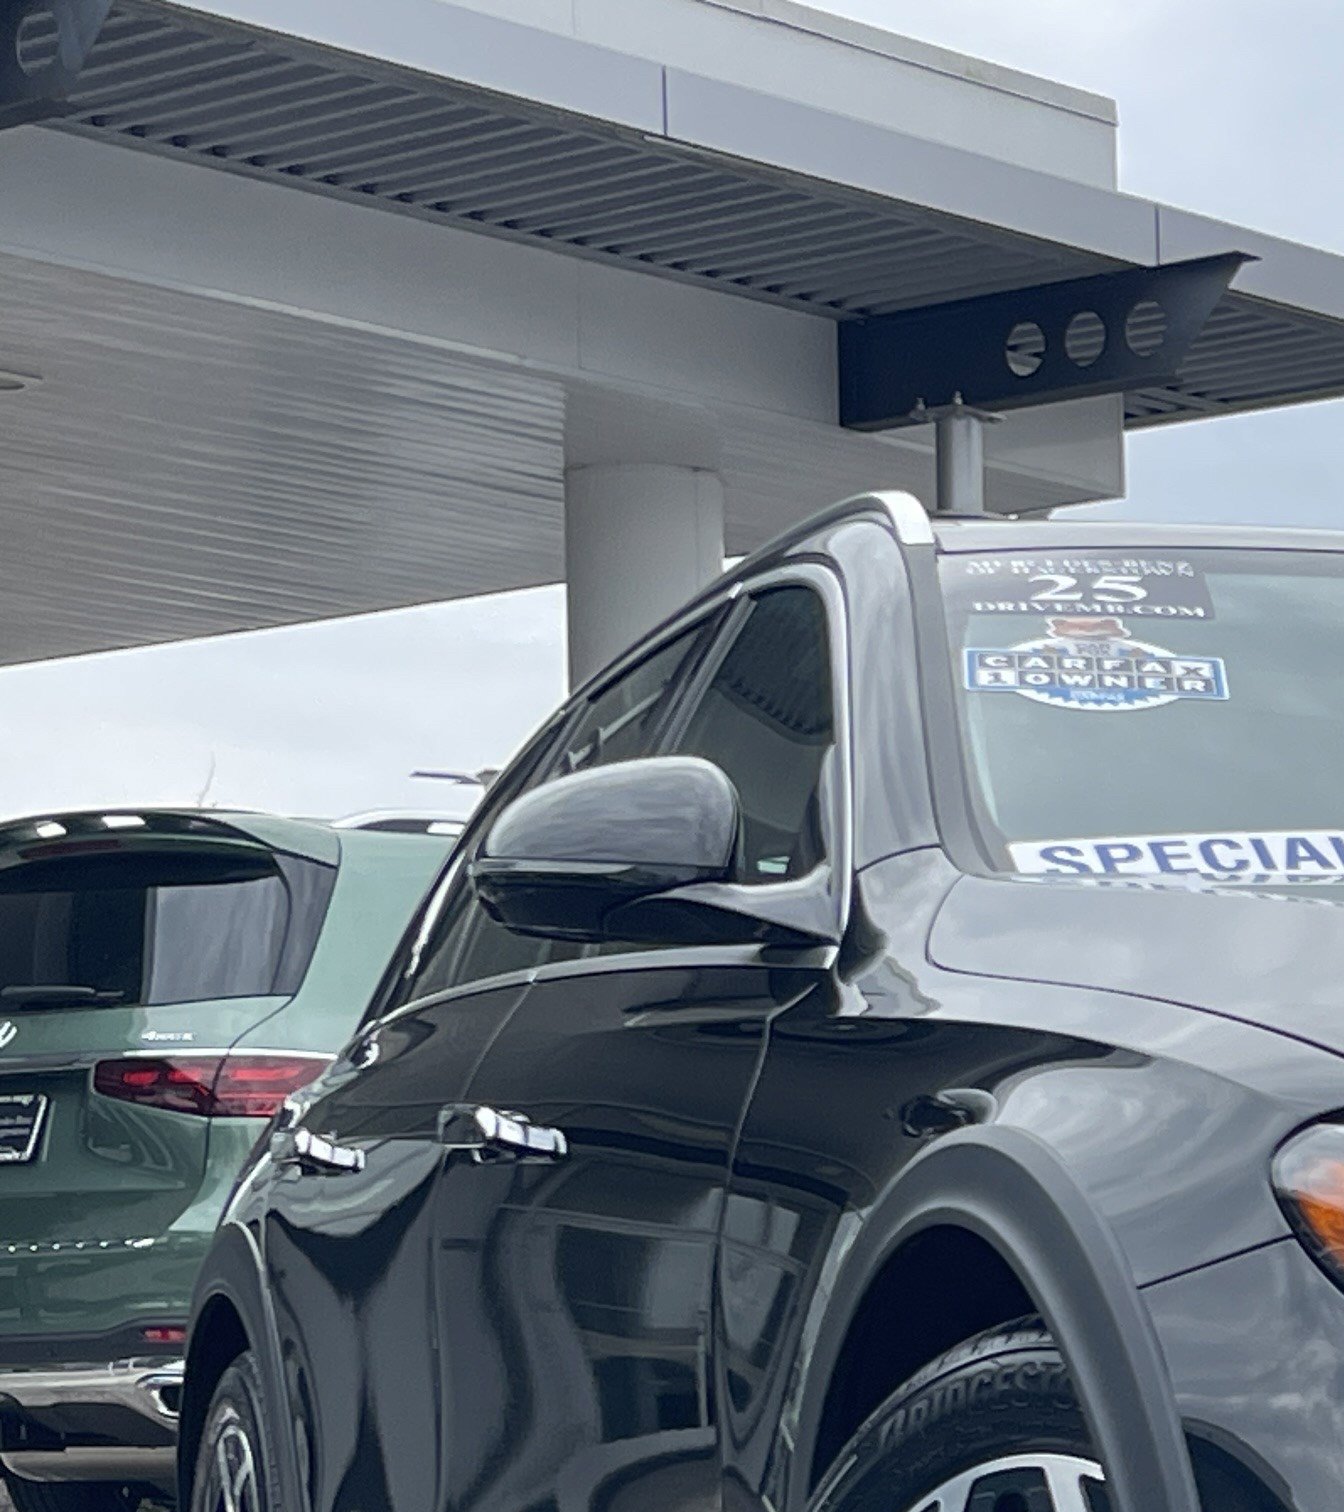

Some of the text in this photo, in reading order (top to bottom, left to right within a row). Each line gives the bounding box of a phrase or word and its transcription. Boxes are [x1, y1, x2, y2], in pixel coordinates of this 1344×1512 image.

[1028, 574, 1148, 602] 25
[973, 601, 1205, 618] DRIVEMB.COM
[984, 655, 1207, 677] CARFAX
[1024, 673, 1207, 692] OWNER
